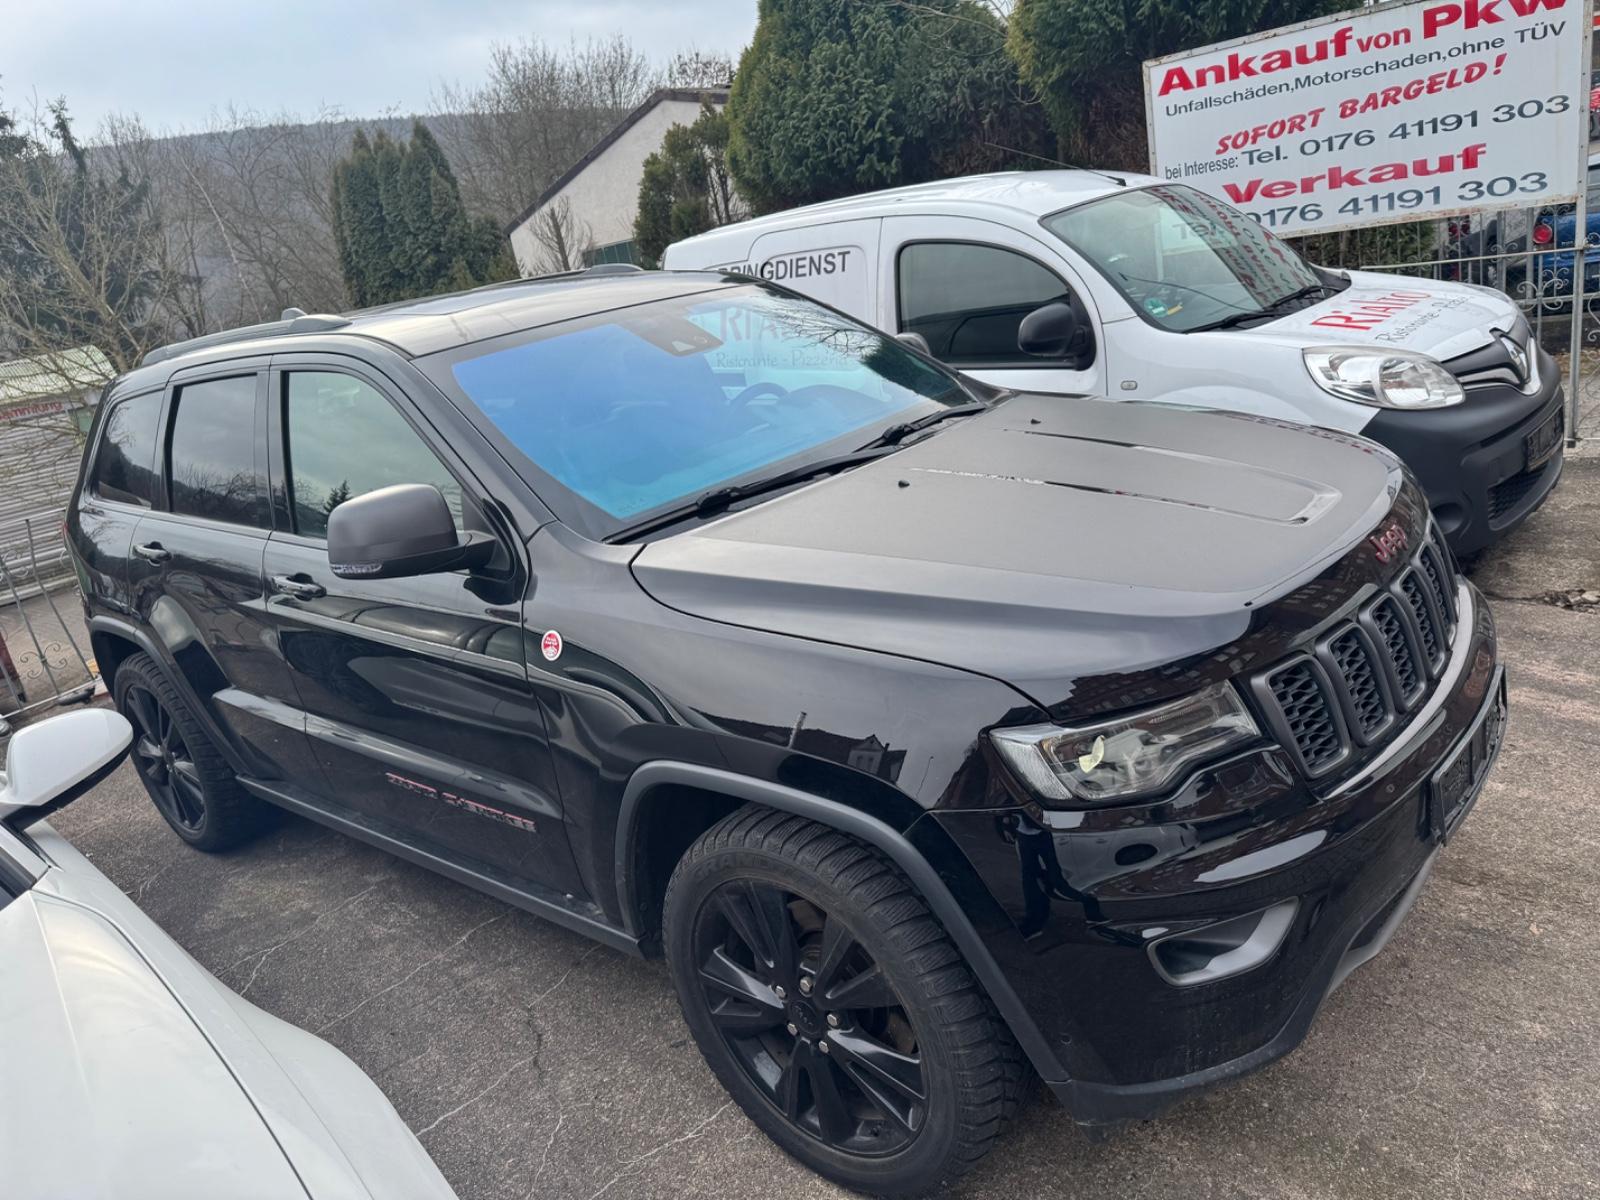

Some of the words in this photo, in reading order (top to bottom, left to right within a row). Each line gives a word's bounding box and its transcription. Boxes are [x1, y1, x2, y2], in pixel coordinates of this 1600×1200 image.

[1514, 21, 1566, 43] TÜV
[1158, 26, 1353, 96] Ankauf
[1356, 27, 1411, 54] von
[1165, 165, 1182, 180] bei
[1184, 156, 1239, 177] Interesse:
[1241, 145, 1288, 166] Tel.
[1299, 129, 1376, 156] 0176
[1388, 110, 1478, 140] 41191
[1492, 94, 1570, 123] 303
[1215, 107, 1325, 155] SOFORT
[1222, 143, 1487, 205] Verkauf
[1337, 186, 1441, 216] 41191
[1457, 172, 1549, 201] 303
[718, 250, 851, 281] INGDIENST
[1369, 524, 1409, 563] Jeep
